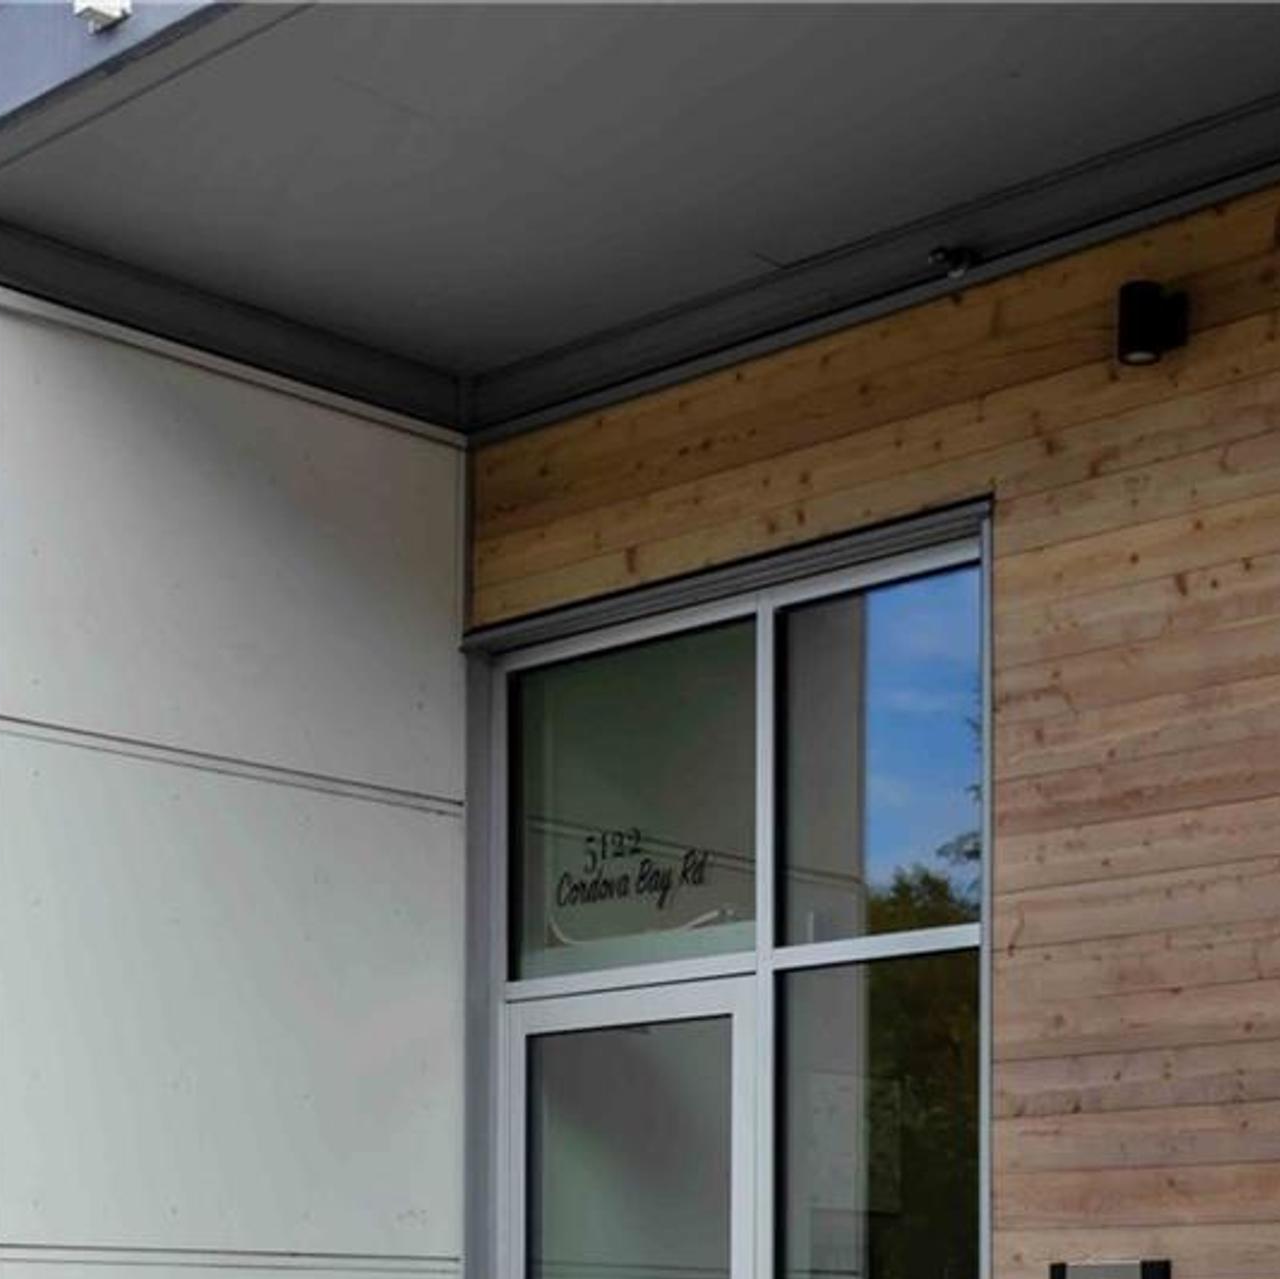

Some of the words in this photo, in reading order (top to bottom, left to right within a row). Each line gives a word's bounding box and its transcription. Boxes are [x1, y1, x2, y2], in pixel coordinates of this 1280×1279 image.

[556, 866, 630, 907] Cordova
[635, 858, 673, 910] Bay
[679, 848, 709, 885] Rd
